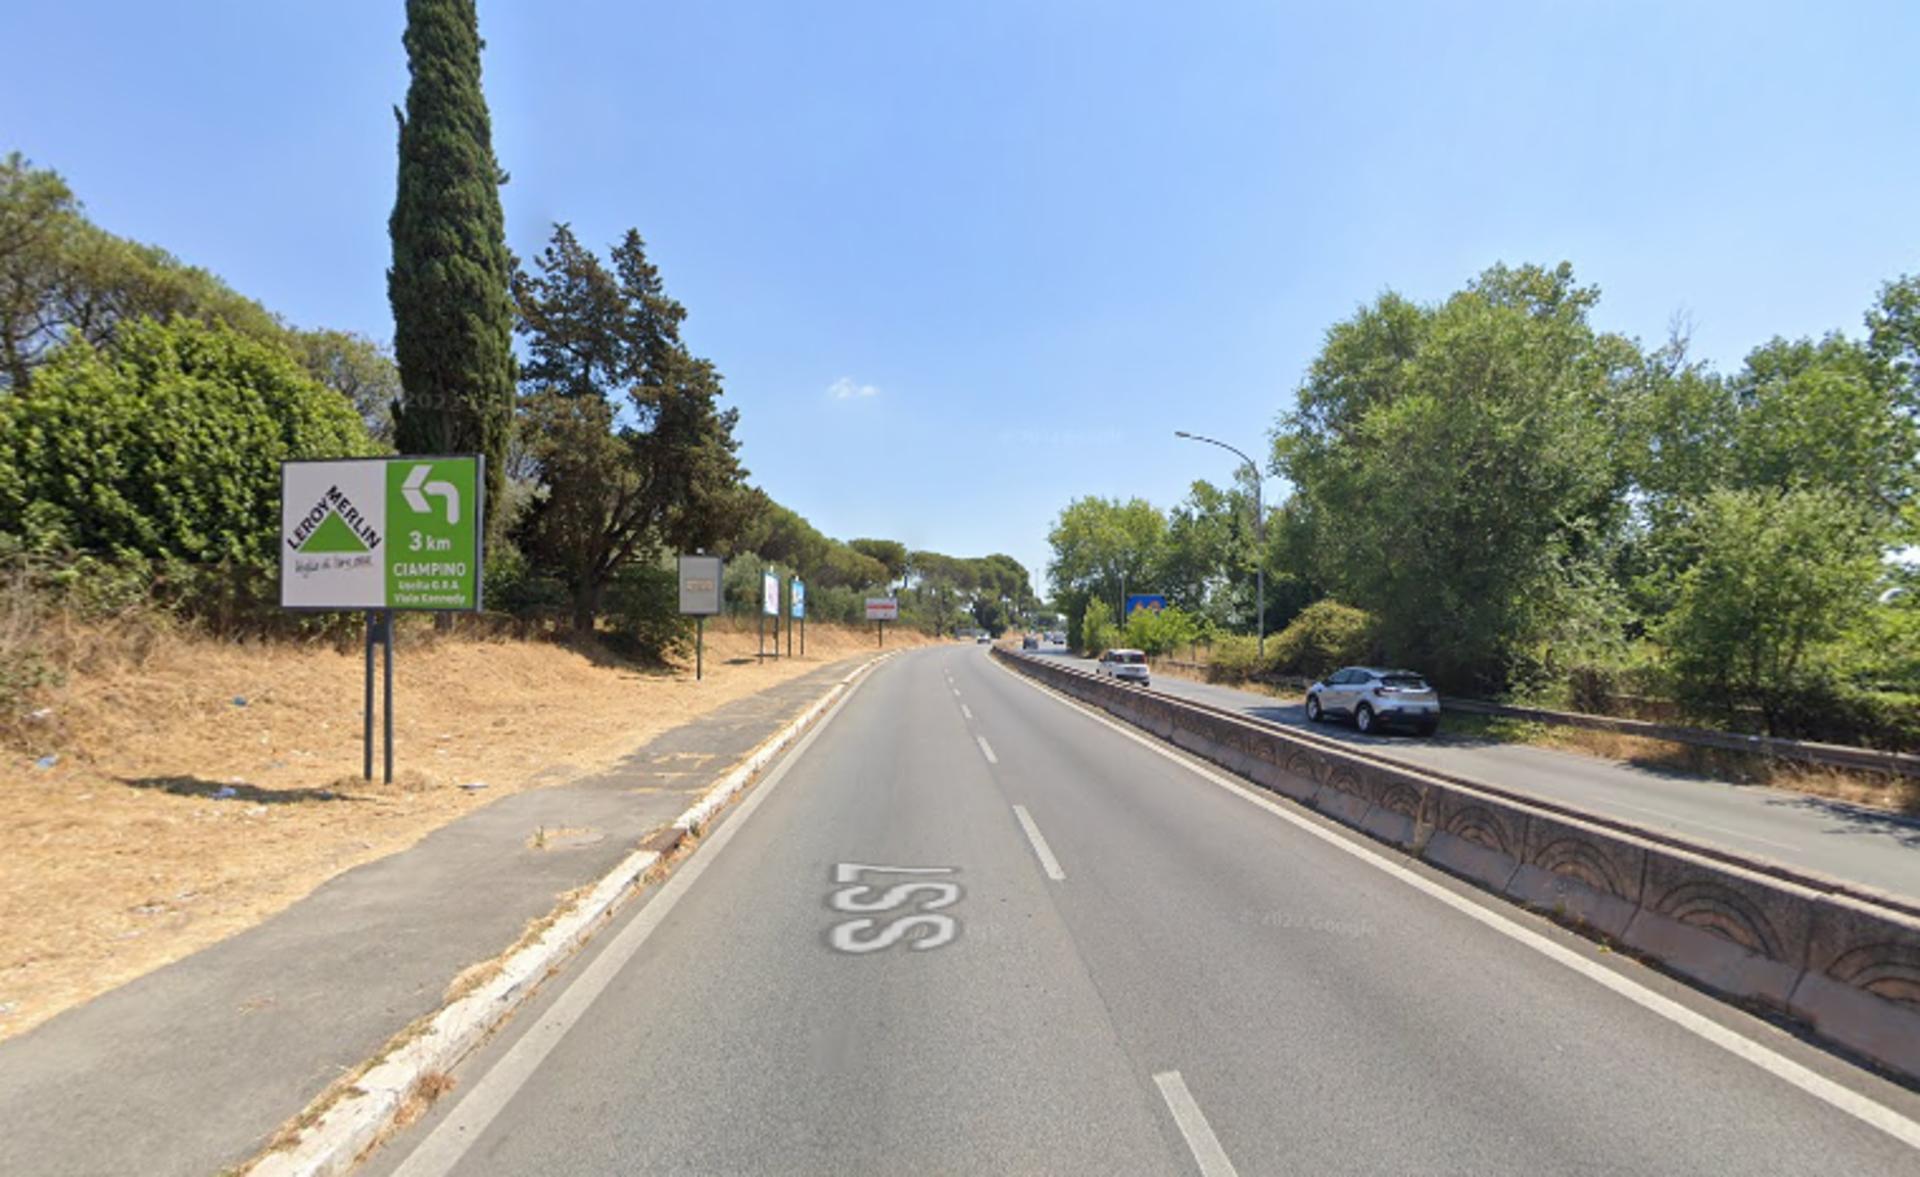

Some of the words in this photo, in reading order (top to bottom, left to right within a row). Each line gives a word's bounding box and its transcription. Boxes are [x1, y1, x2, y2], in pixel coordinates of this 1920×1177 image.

[287, 496, 329, 549] LEROY
[326, 484, 382, 549] MERLIN
[409, 529, 422, 552] 3
[426, 534, 451, 551] km
[393, 562, 466, 577] CIAMPINO
